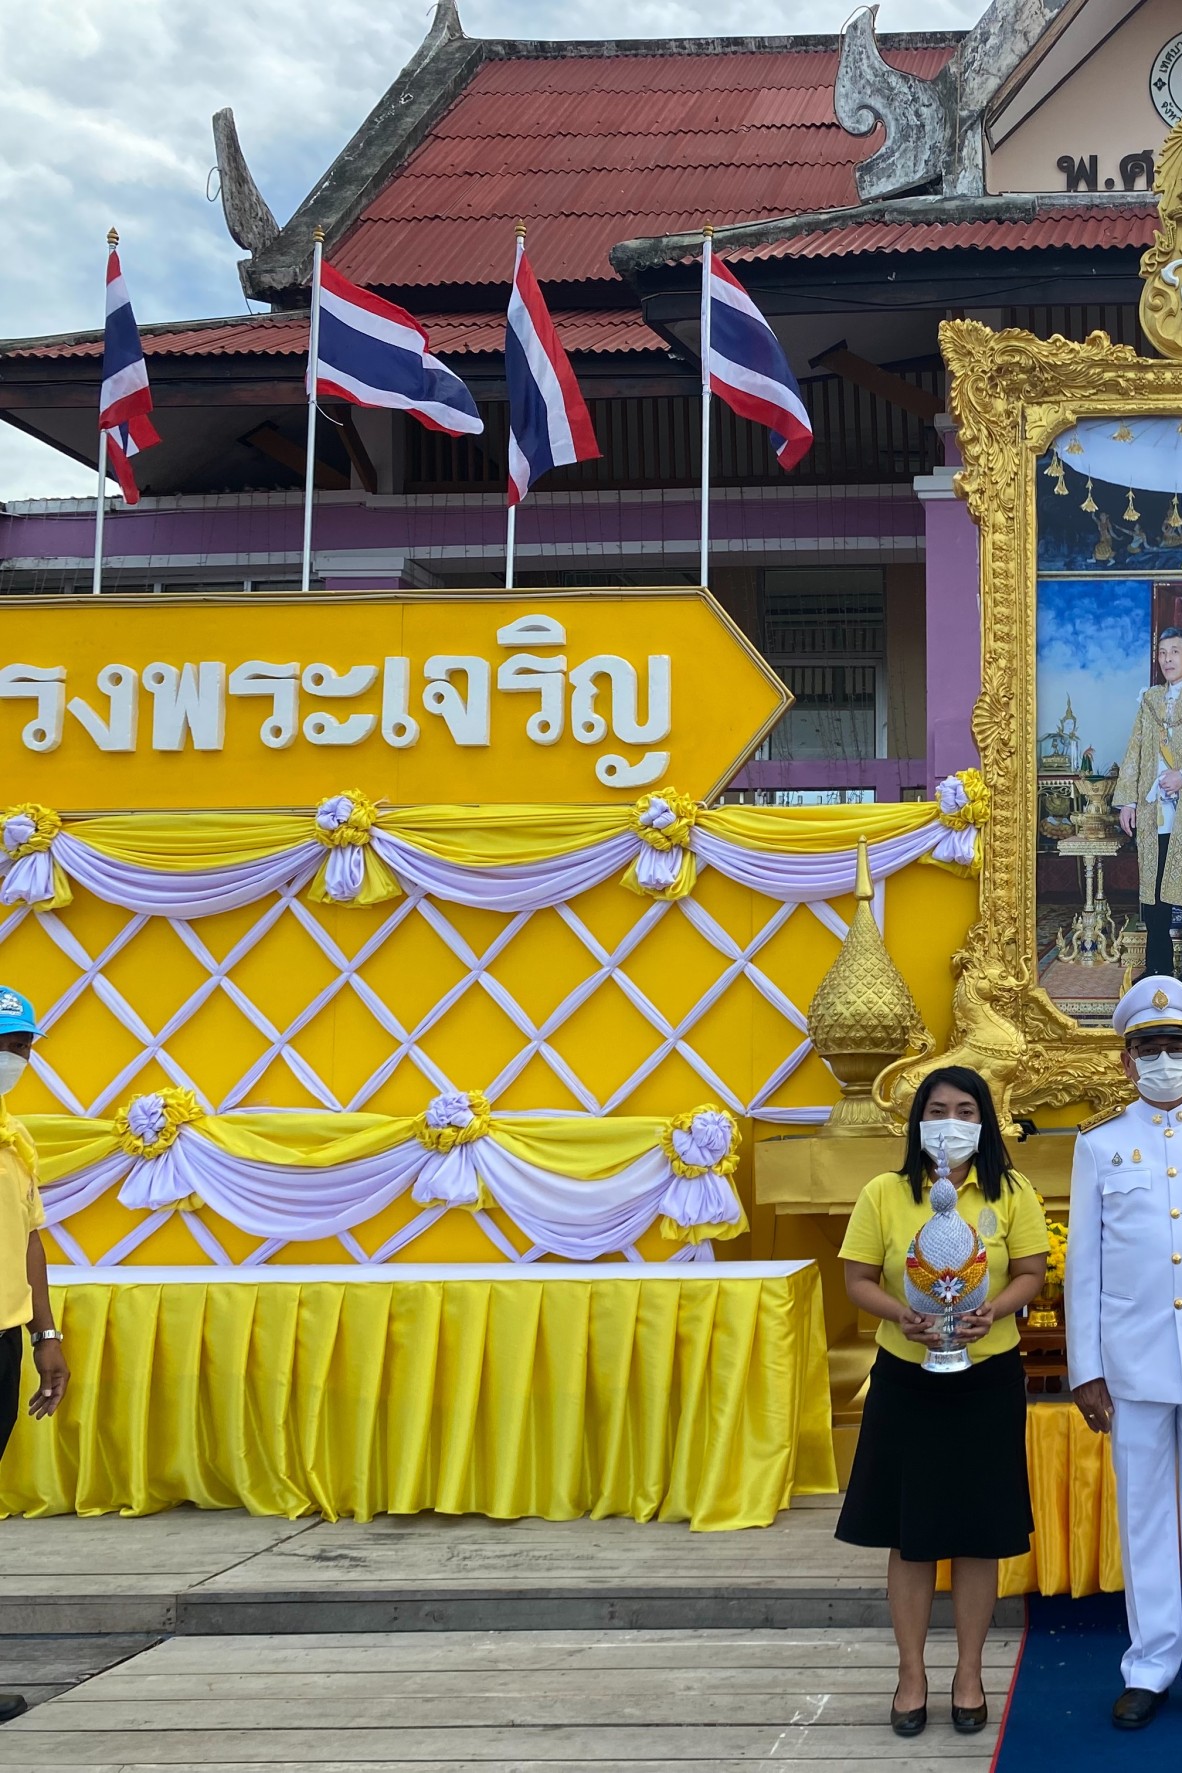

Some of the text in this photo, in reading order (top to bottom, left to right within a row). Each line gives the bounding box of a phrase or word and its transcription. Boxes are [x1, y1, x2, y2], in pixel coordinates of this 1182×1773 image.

[1056, 149, 1155, 191] พ.ศ
[0, 613, 671, 789] รงพระเจริญ
